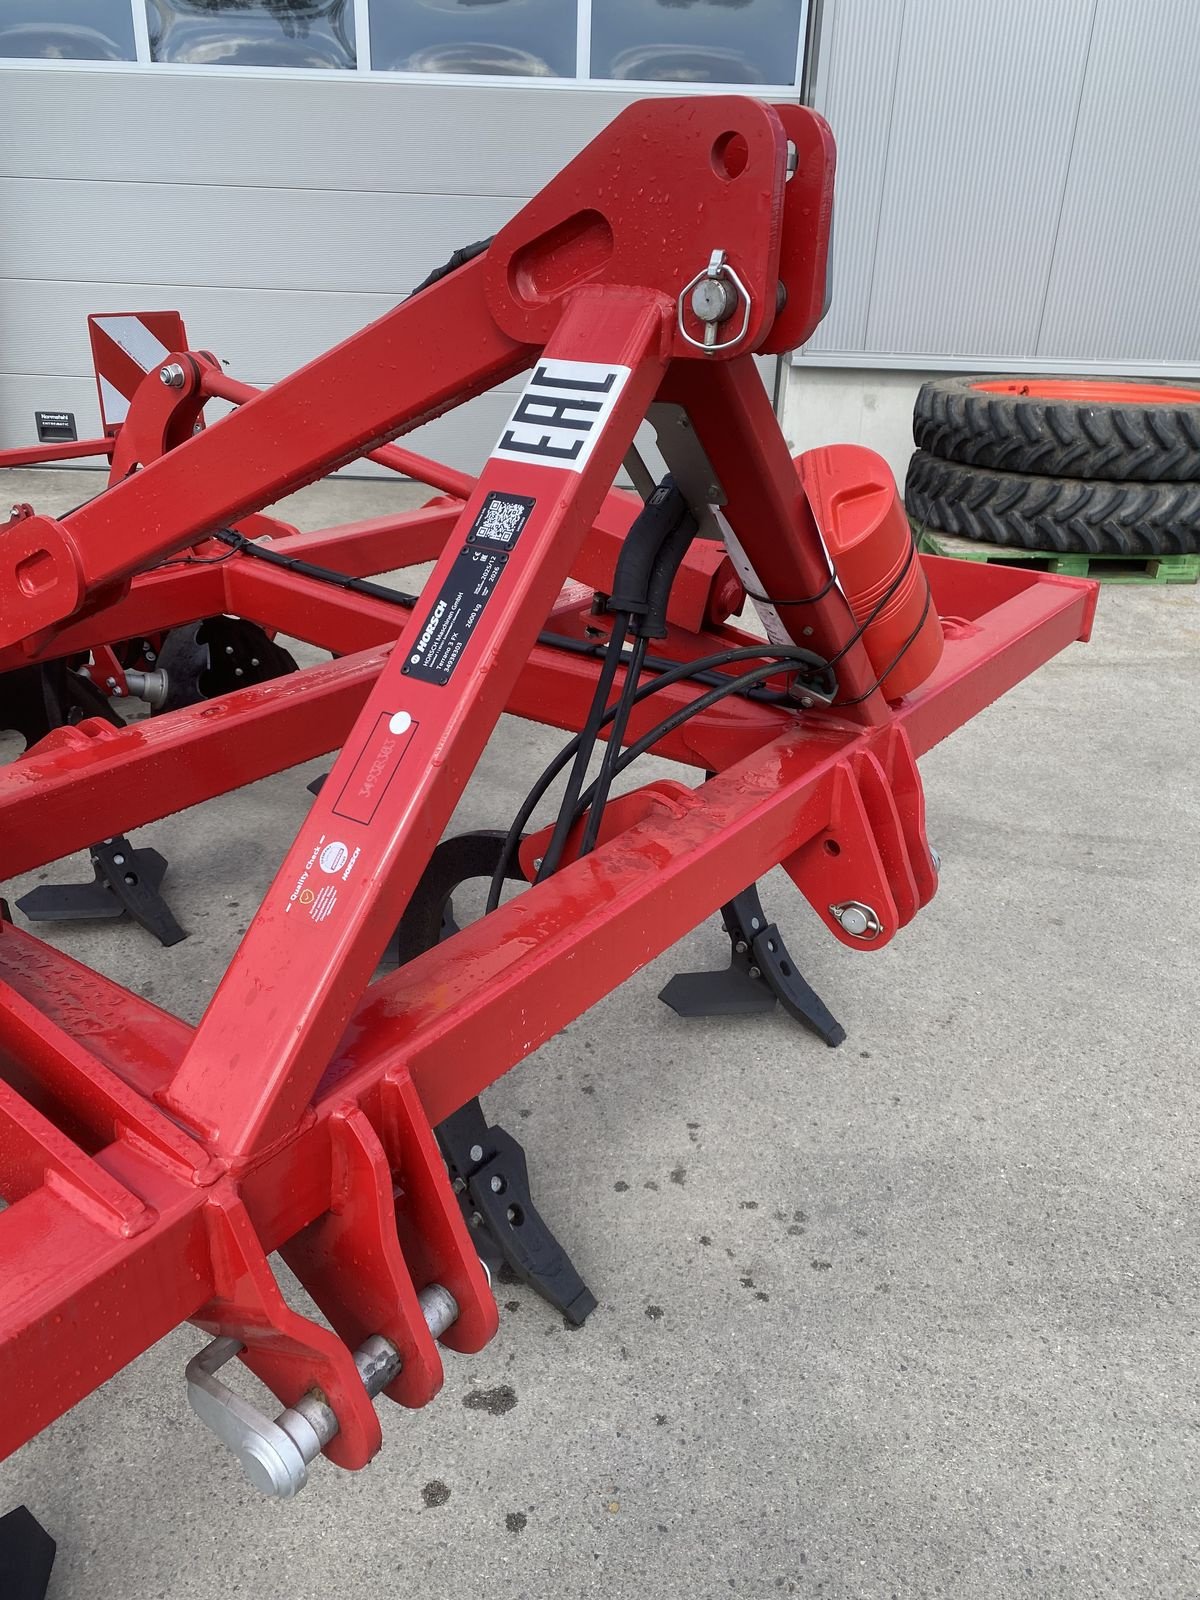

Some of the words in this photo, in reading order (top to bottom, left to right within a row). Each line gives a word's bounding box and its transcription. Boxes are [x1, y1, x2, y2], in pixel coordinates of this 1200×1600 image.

[498, 366, 617, 460] EAC
[481, 556, 496, 580] 2025/12
[489, 566, 500, 582] 2026
[416, 600, 447, 652] HORSCH
[423, 641, 438, 667] HORSCH
[436, 611, 454, 641] Maschinen
[452, 592, 464, 610] GmbH
[466, 612, 476, 628] 2600
[473, 603, 482, 612] kg
[436, 647, 451, 670] Terrano
[451, 632, 459, 641] FX
[444, 642, 462, 672] 34938303
[290, 871, 309, 901] Quality
[306, 846, 320, 870] Check
[342, 846, 361, 881] HORSCH
